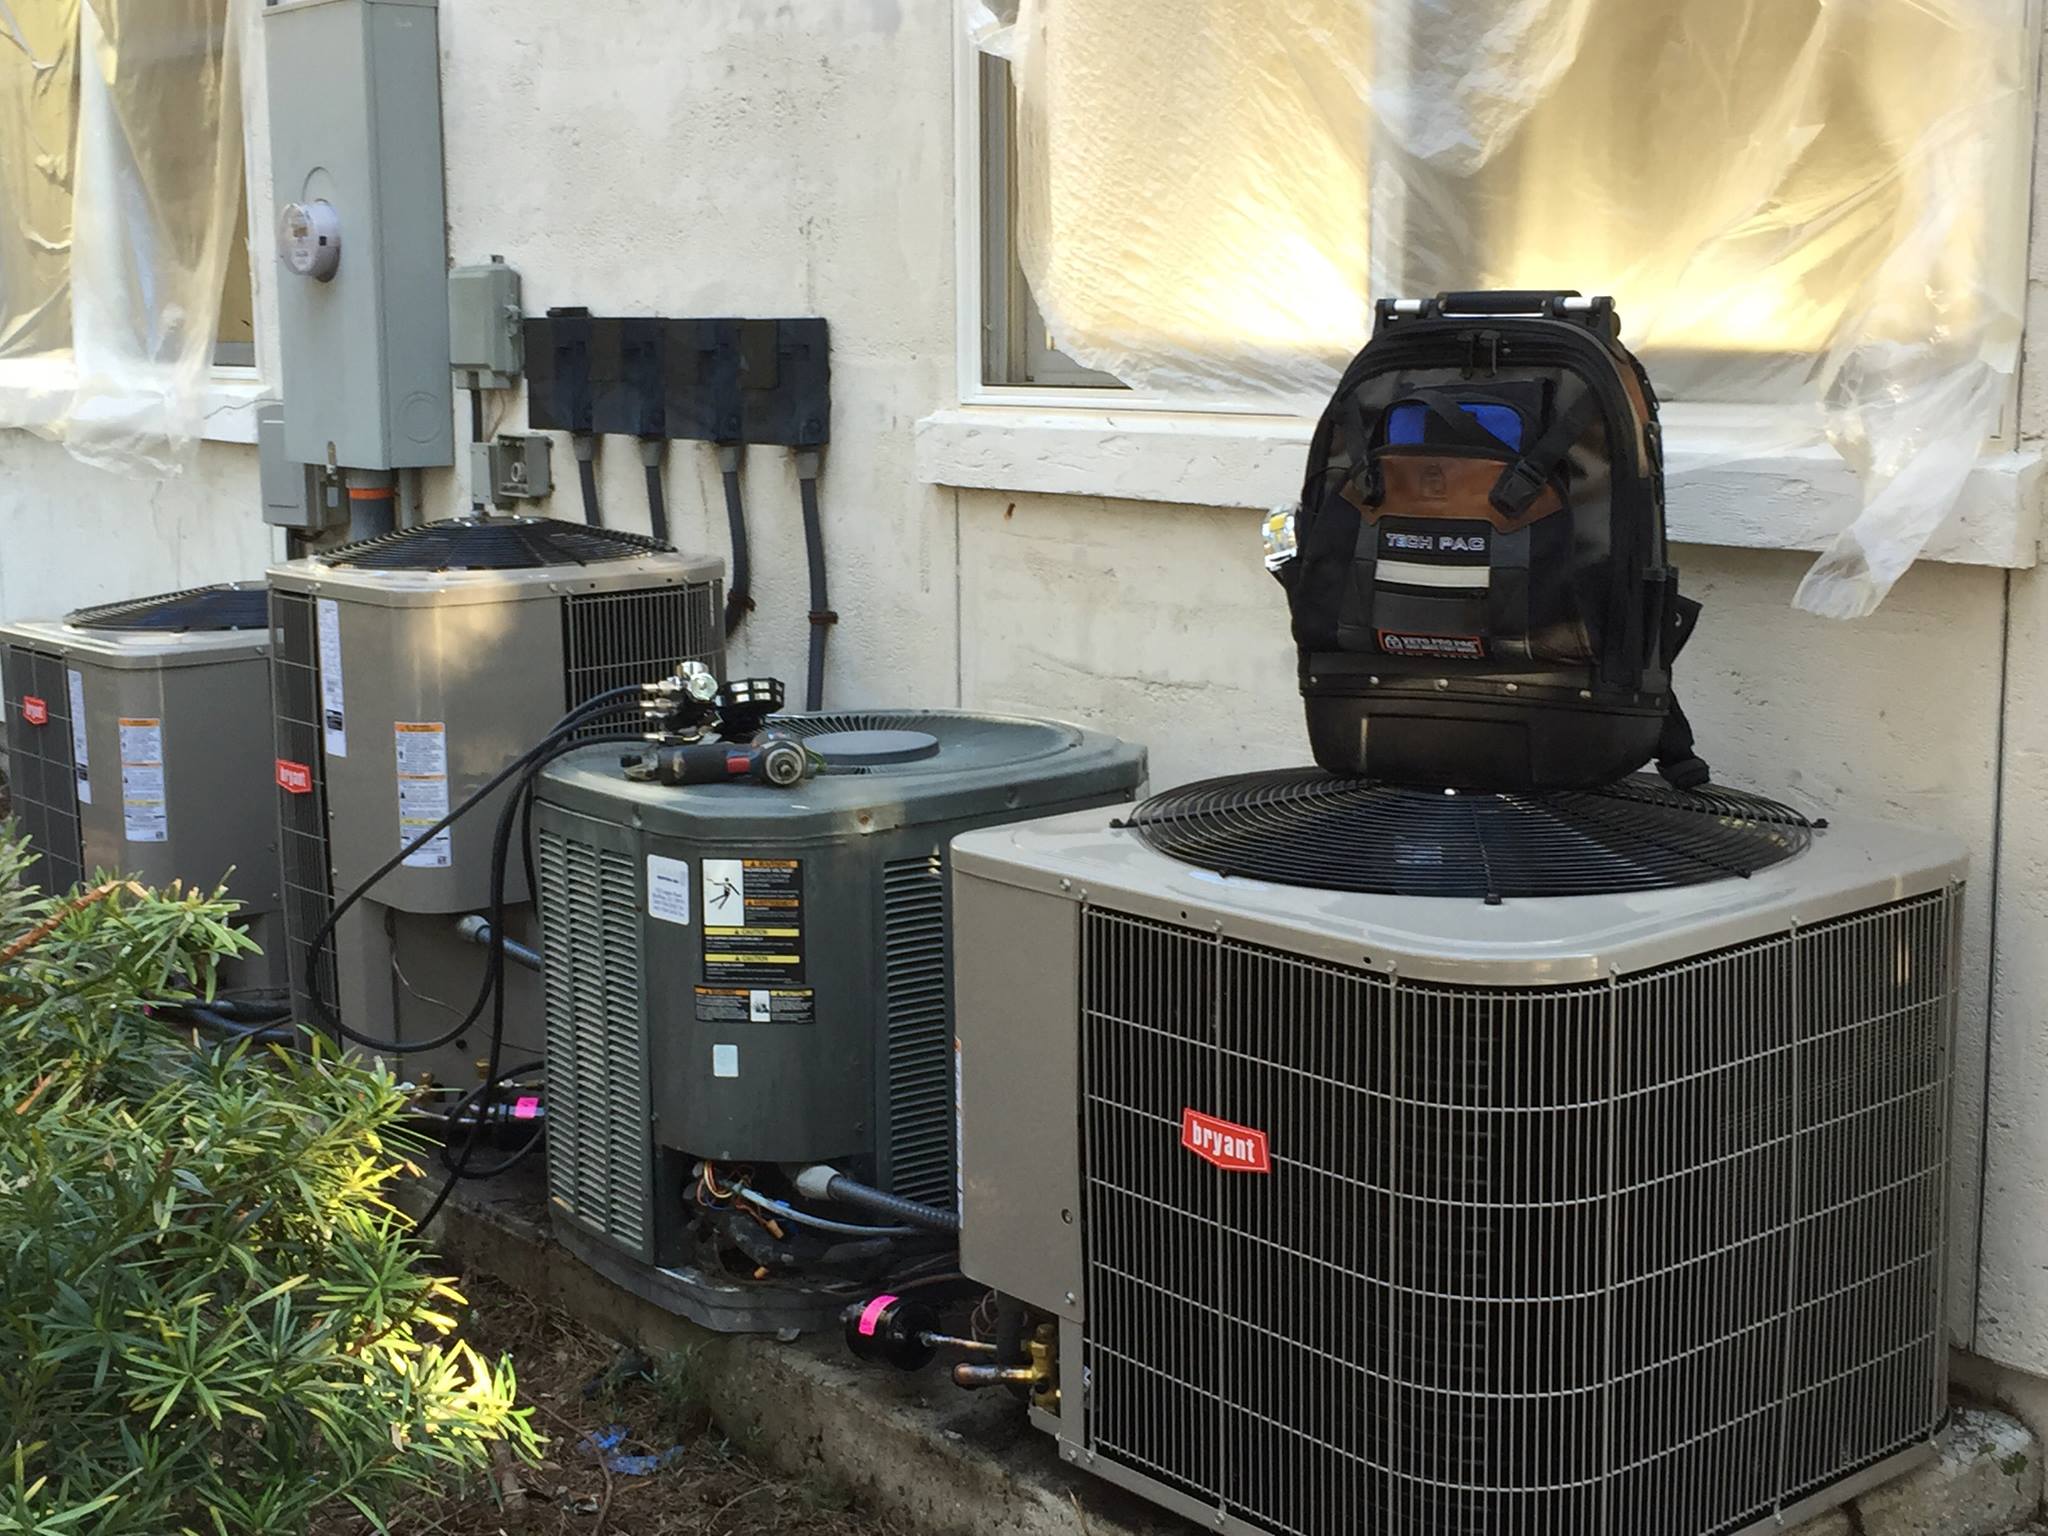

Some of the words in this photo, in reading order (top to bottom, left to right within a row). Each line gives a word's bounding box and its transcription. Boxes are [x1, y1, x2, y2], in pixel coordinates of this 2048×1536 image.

[1385, 533, 1433, 550] TECH
[1439, 536, 1486, 552] PAC
[1192, 1119, 1256, 1164] bryant
